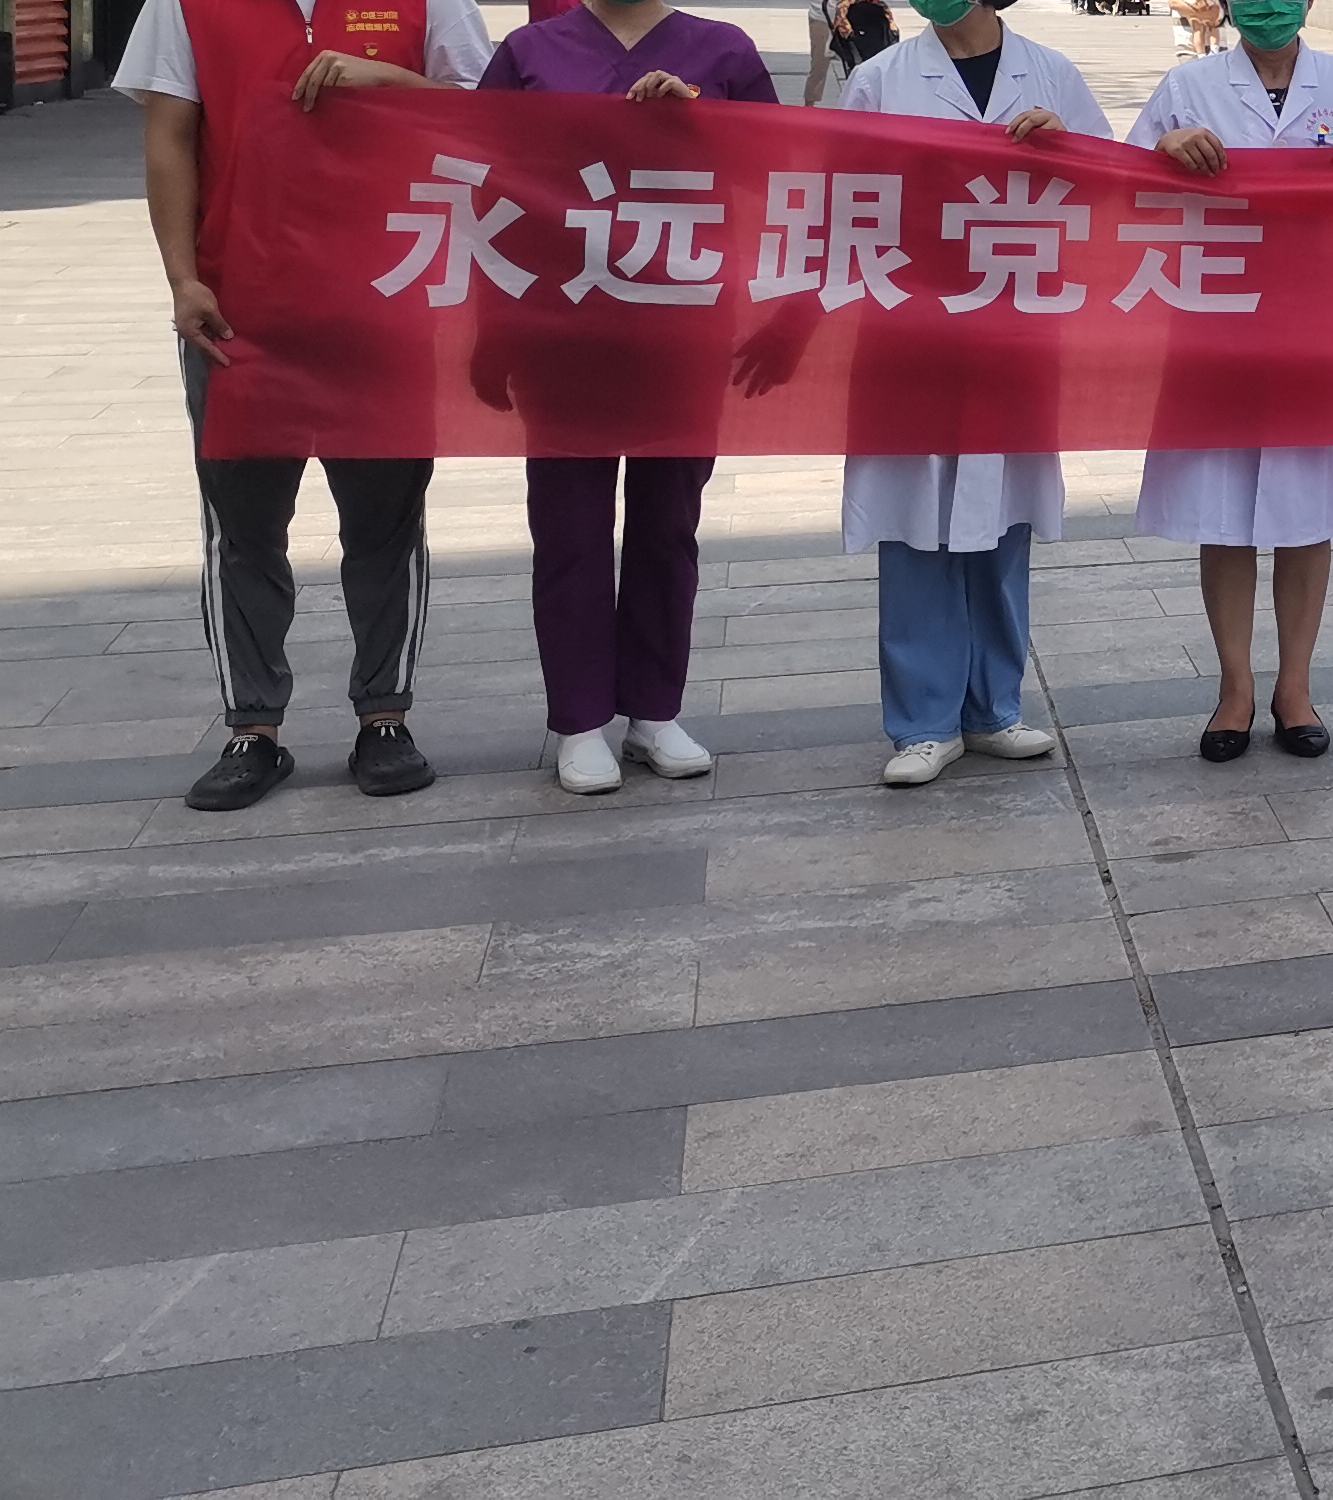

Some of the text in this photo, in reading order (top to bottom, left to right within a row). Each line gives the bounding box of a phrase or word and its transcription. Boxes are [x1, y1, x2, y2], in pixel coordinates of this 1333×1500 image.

[370, 154, 1265, 314] 永远跟党走
